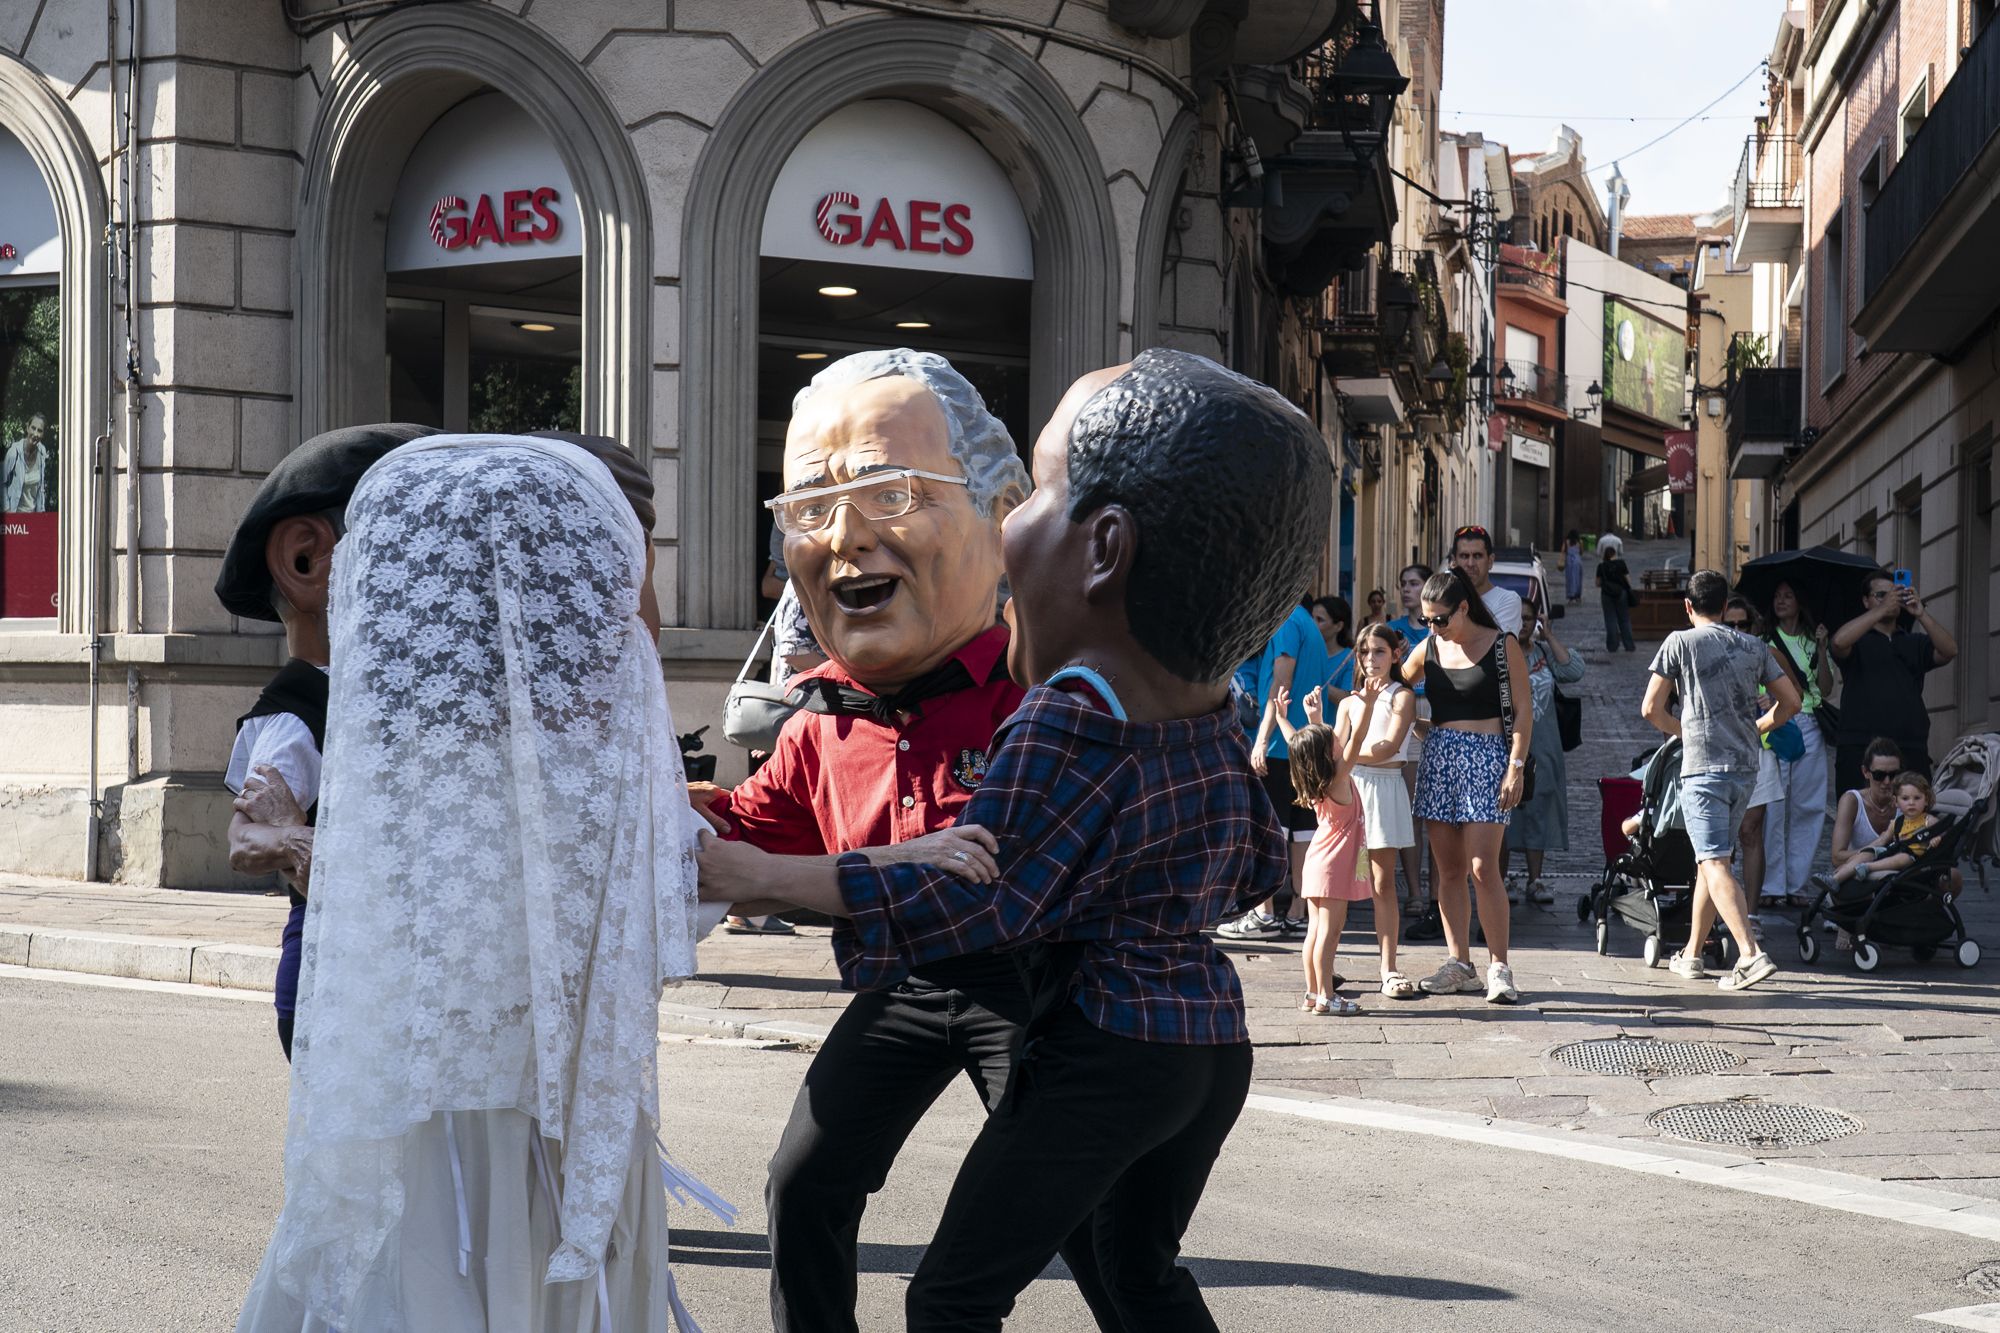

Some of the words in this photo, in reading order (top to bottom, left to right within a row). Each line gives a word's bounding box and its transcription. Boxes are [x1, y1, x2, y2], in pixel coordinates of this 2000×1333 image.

[429, 186, 561, 249] GAES
[816, 191, 974, 256] GAES
[1496, 638, 1505, 664] LOLA
